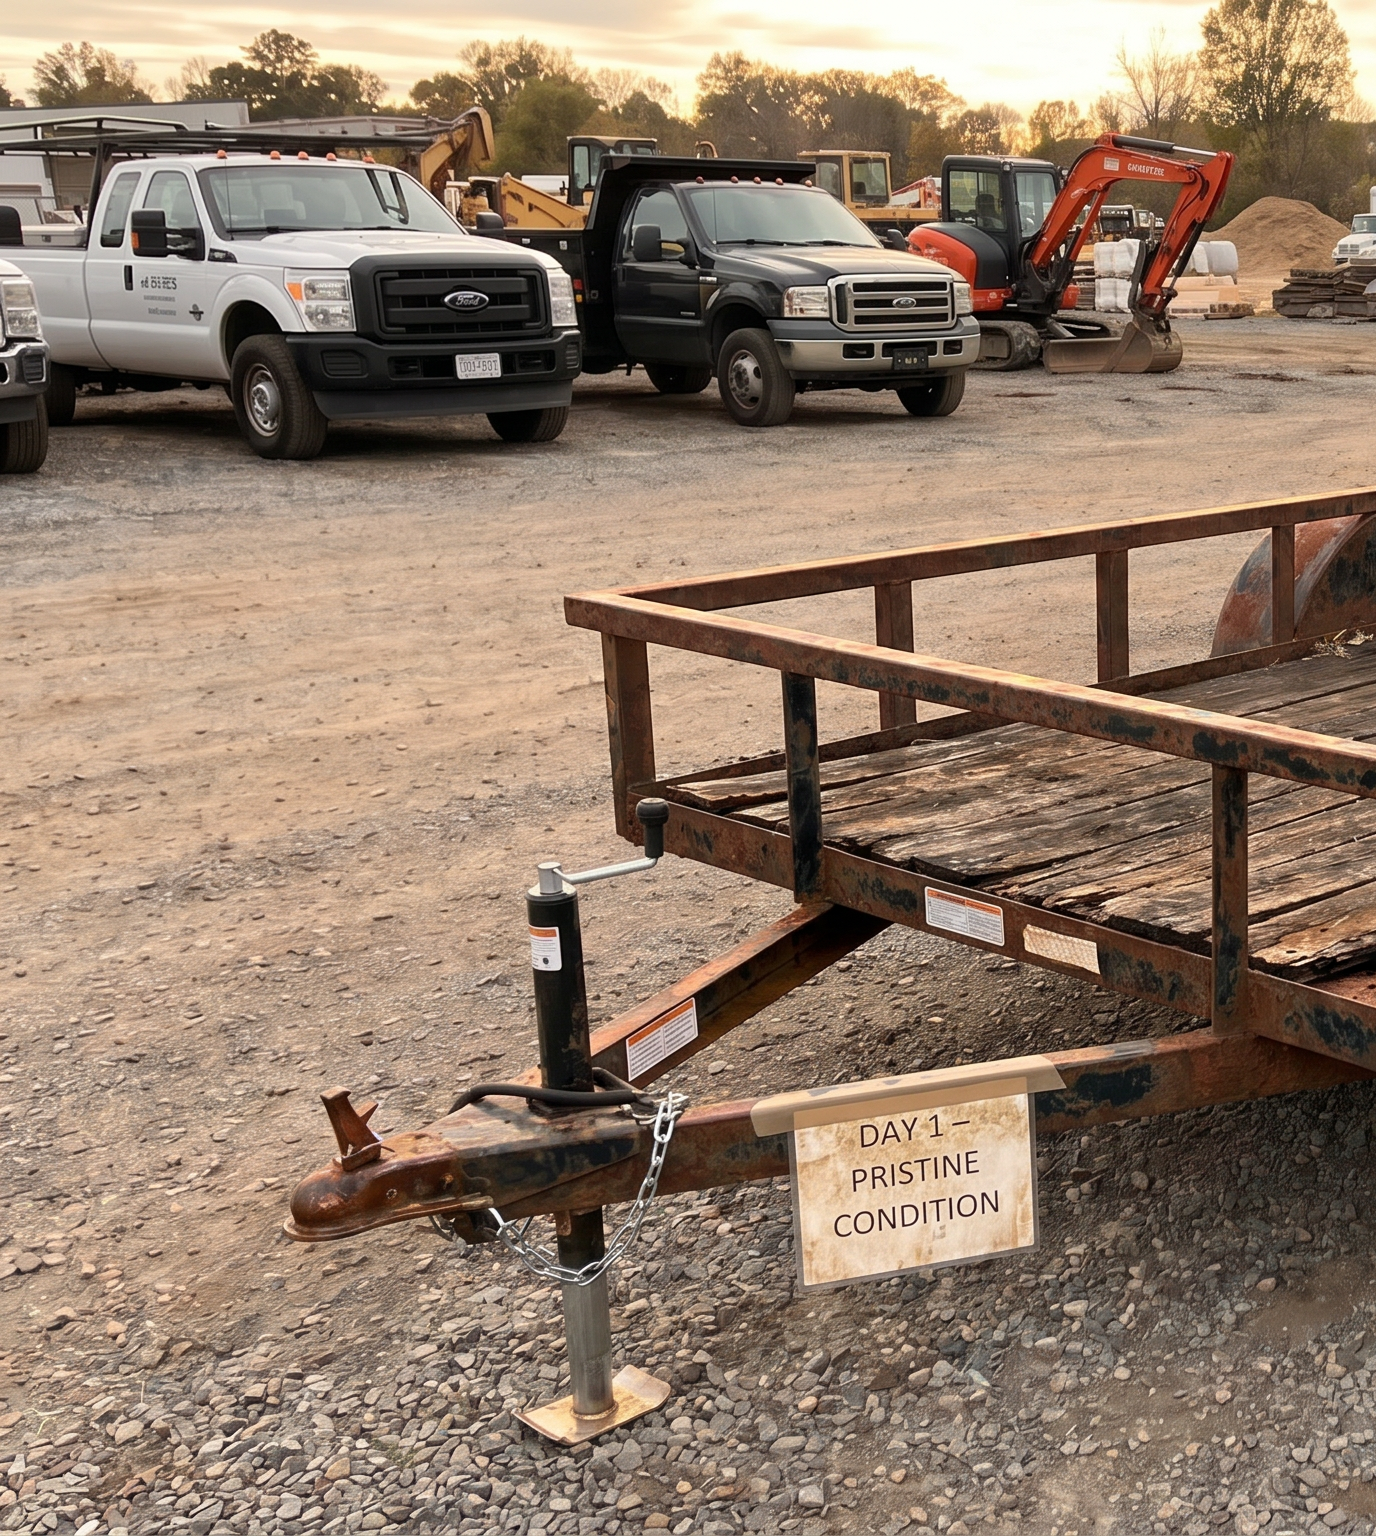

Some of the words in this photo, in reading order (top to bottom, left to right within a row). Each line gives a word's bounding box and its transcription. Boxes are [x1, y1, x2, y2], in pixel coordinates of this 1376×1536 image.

[860, 1117, 918, 1148] DAY
[928, 1114, 944, 1138] 1
[852, 1150, 980, 1192] PRISTINE
[834, 1190, 999, 1238] CONDITION
